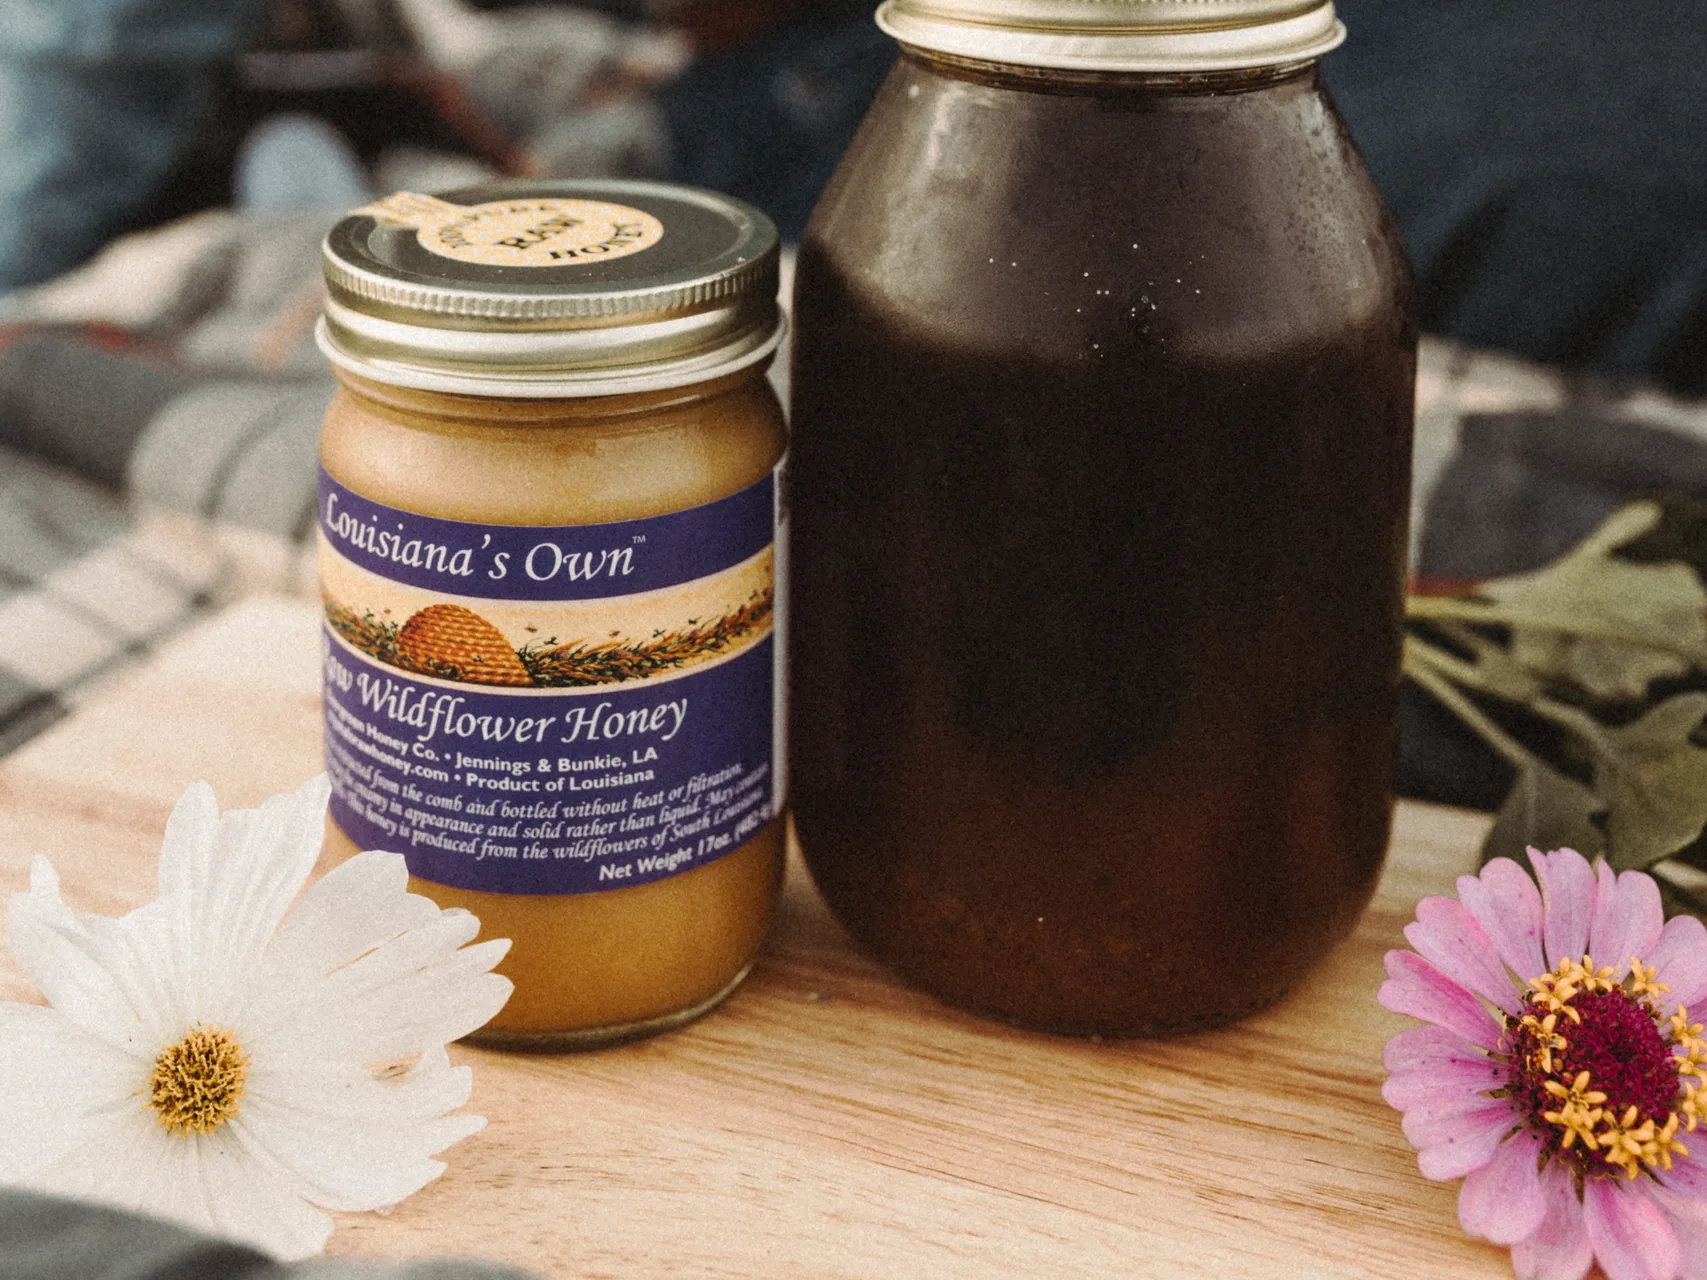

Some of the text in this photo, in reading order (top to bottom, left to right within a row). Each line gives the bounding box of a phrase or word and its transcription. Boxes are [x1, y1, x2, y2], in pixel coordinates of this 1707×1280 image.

[497, 214, 585, 250] RAW
[549, 222, 644, 260] HONEY
[326, 492, 511, 580] Louisiana's
[357, 672, 557, 743] Wildflower
[560, 697, 688, 744] Honey
[366, 722, 409, 755] Honey
[411, 742, 440, 762] Co.
[455, 751, 532, 776] Jennings
[537, 758, 552, 773] &
[558, 754, 628, 773] Bunkie,
[632, 746, 659, 765] LA
[369, 769, 400, 795] from
[402, 783, 423, 803] the
[425, 794, 463, 812] comb
[466, 799, 500, 817] and
[500, 800, 561, 819] bottled
[562, 797, 629, 819] without
[632, 791, 664, 810] heat
[668, 785, 683, 802] or
[466, 772, 541, 793] Product
[545, 776, 566, 793] of
[569, 769, 656, 792] Louisiana
[365, 800, 398, 837] honey
[398, 825, 410, 838] is
[411, 828, 477, 855] produced
[475, 838, 519, 861] from
[522, 842, 549, 859] the
[552, 836, 649, 863] wildflowers
[651, 827, 669, 850] of
[669, 810, 711, 843] South
[389, 797, 403, 816] in
[404, 805, 484, 835] appearance
[487, 819, 518, 839] and
[522, 821, 561, 840] solid
[566, 818, 616, 839] rather
[619, 812, 655, 832] than
[598, 863, 633, 881] Net
[636, 846, 693, 872] Weight
